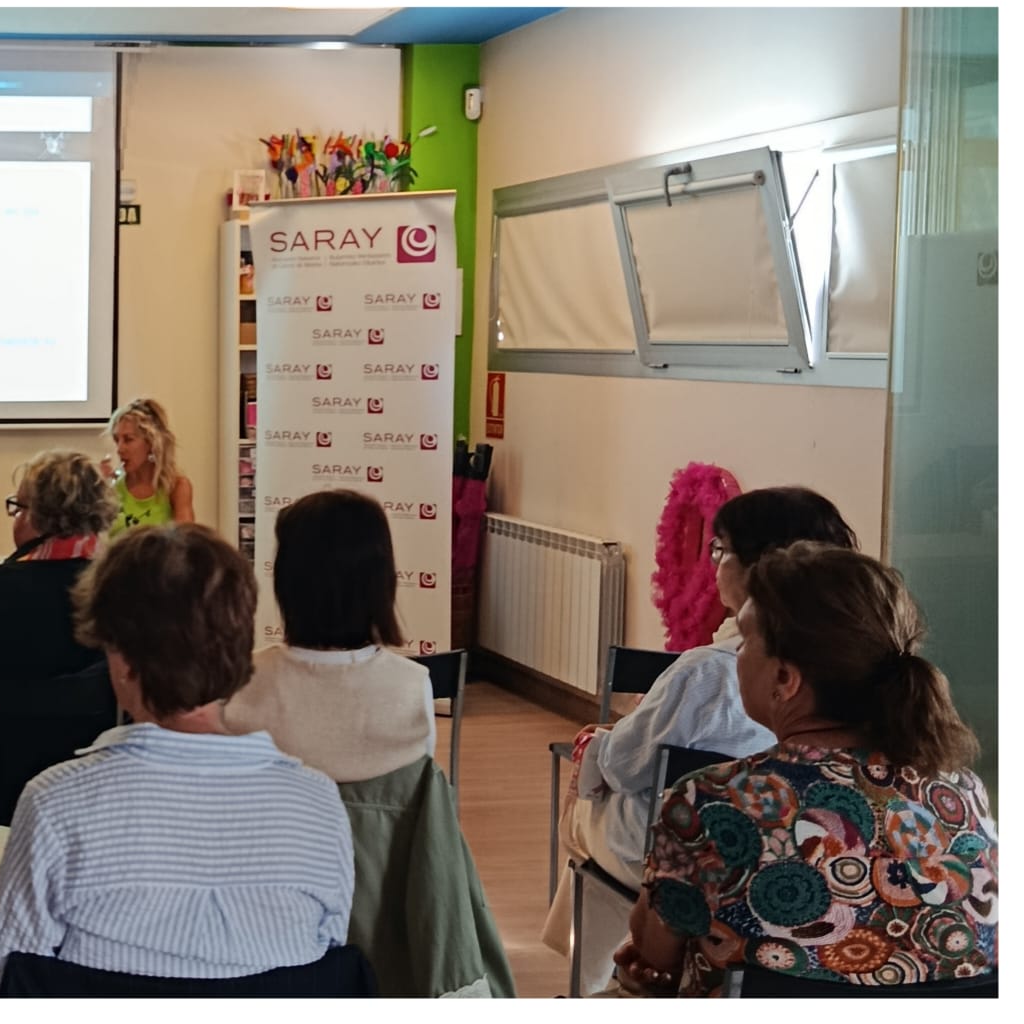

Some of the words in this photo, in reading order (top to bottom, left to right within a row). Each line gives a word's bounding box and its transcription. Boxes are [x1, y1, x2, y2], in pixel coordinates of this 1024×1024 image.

[270, 227, 382, 253] SARAY
[364, 293, 416, 305] SARAY
[312, 328, 362, 339] SARAY
[363, 363, 415, 374] SARAY
[312, 397, 362, 407] SARAY
[264, 430, 311, 441] SARAY
[363, 432, 414, 443] SARAY
[312, 464, 361, 475] SARAY
[264, 496, 293, 506] SAR
[384, 501, 413, 512] RAY
